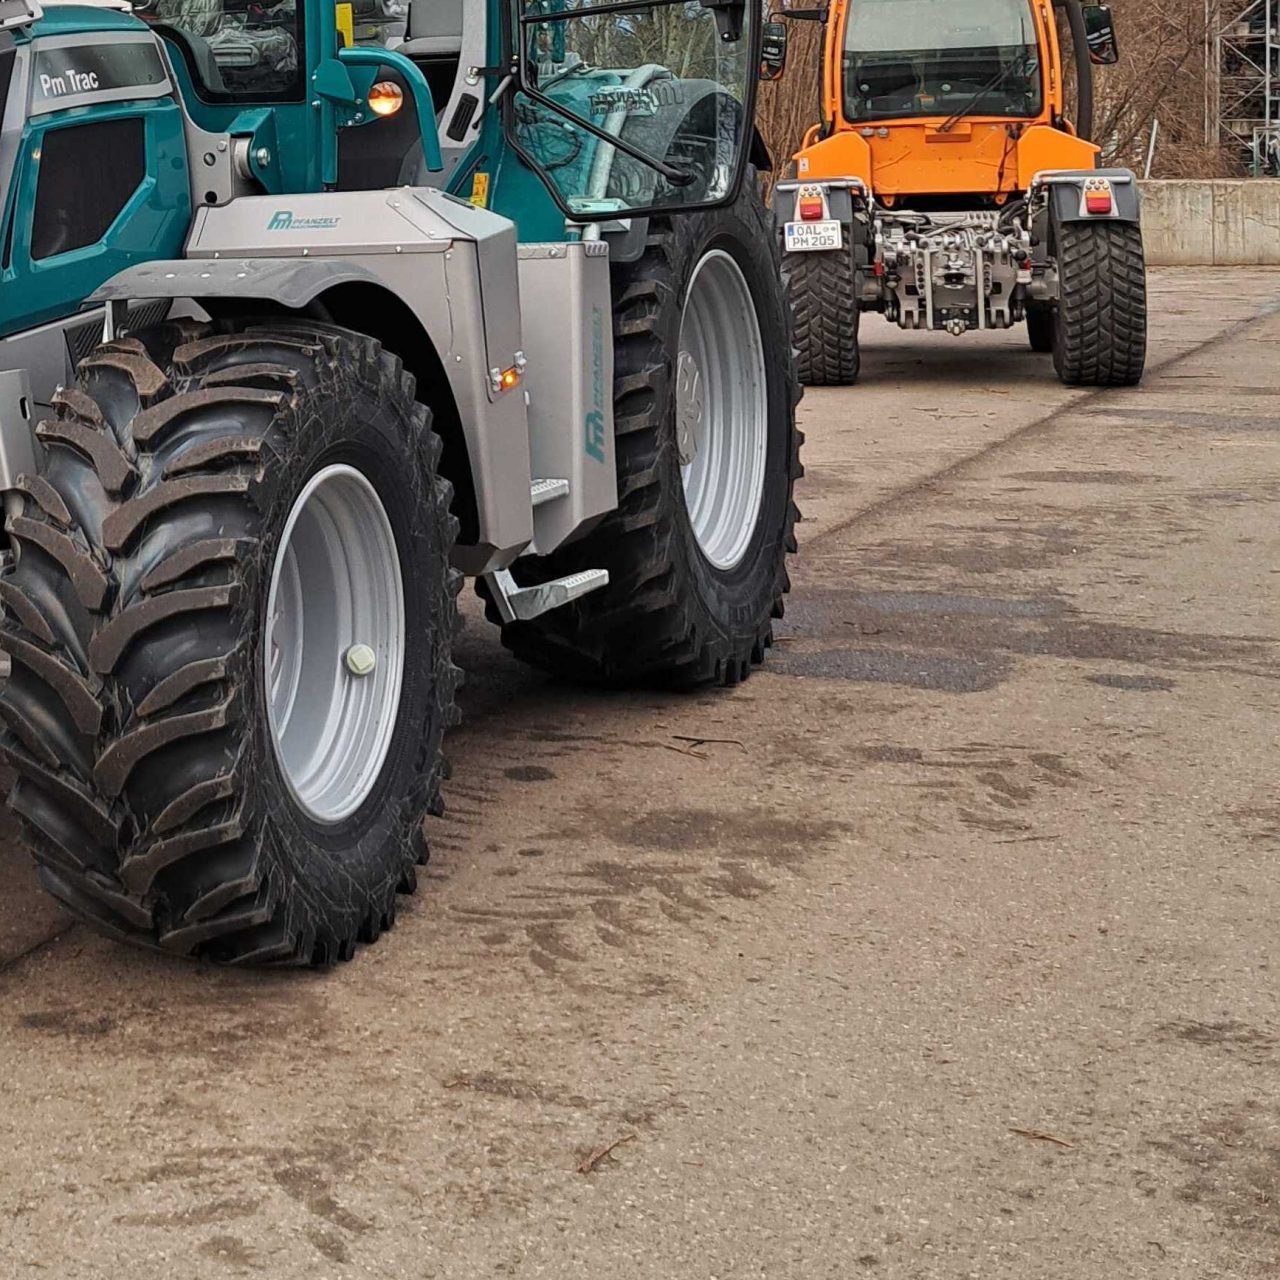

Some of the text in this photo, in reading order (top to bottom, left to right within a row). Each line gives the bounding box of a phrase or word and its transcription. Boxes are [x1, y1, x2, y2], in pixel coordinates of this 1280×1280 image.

[40, 69, 99, 97] Pm Trac
[292, 217, 342, 225] PFANZELT
[796, 225, 822, 236] OAL
[792, 235, 835, 247] PM 205
